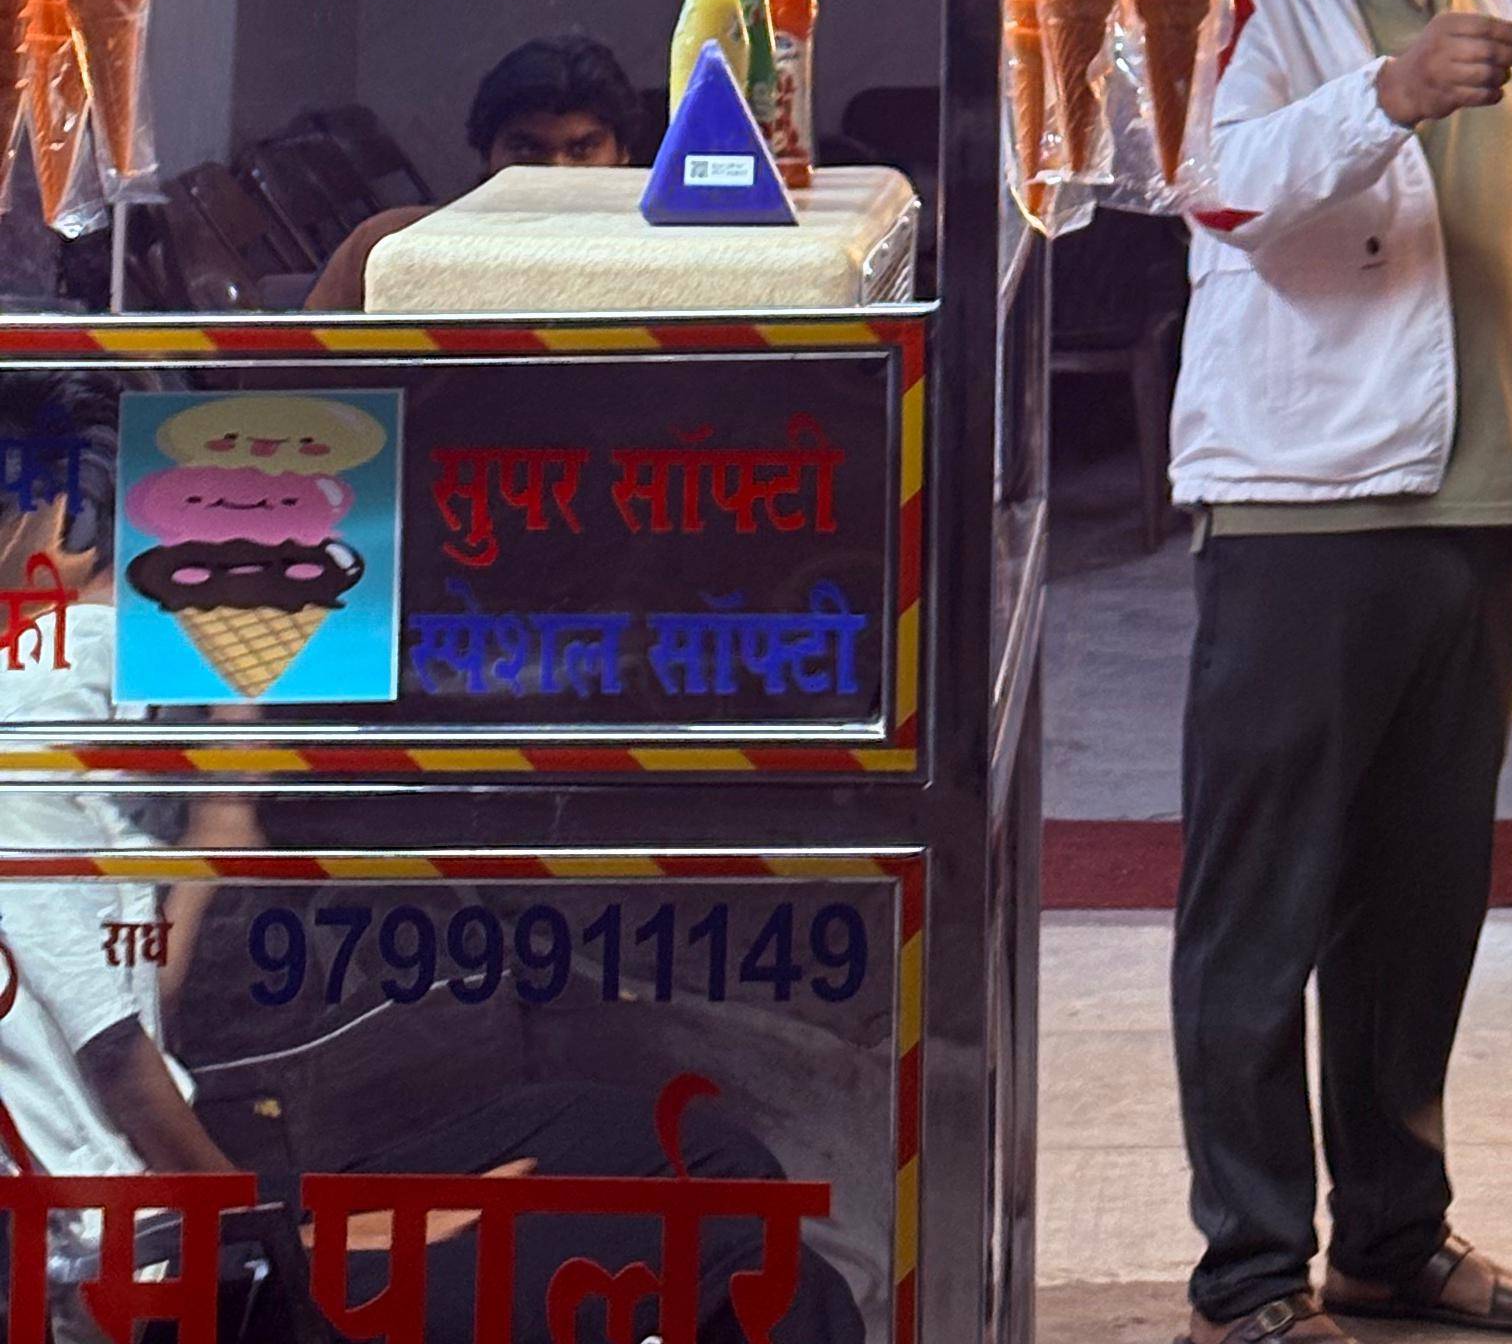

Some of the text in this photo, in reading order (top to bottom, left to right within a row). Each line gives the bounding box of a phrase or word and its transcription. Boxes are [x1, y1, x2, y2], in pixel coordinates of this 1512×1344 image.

[430, 413, 846, 568] सुपर सॉफ्टी
[408, 578, 867, 697] स्पेशल सॉफ्टी
[248, 902, 868, 1006] 9799911149
